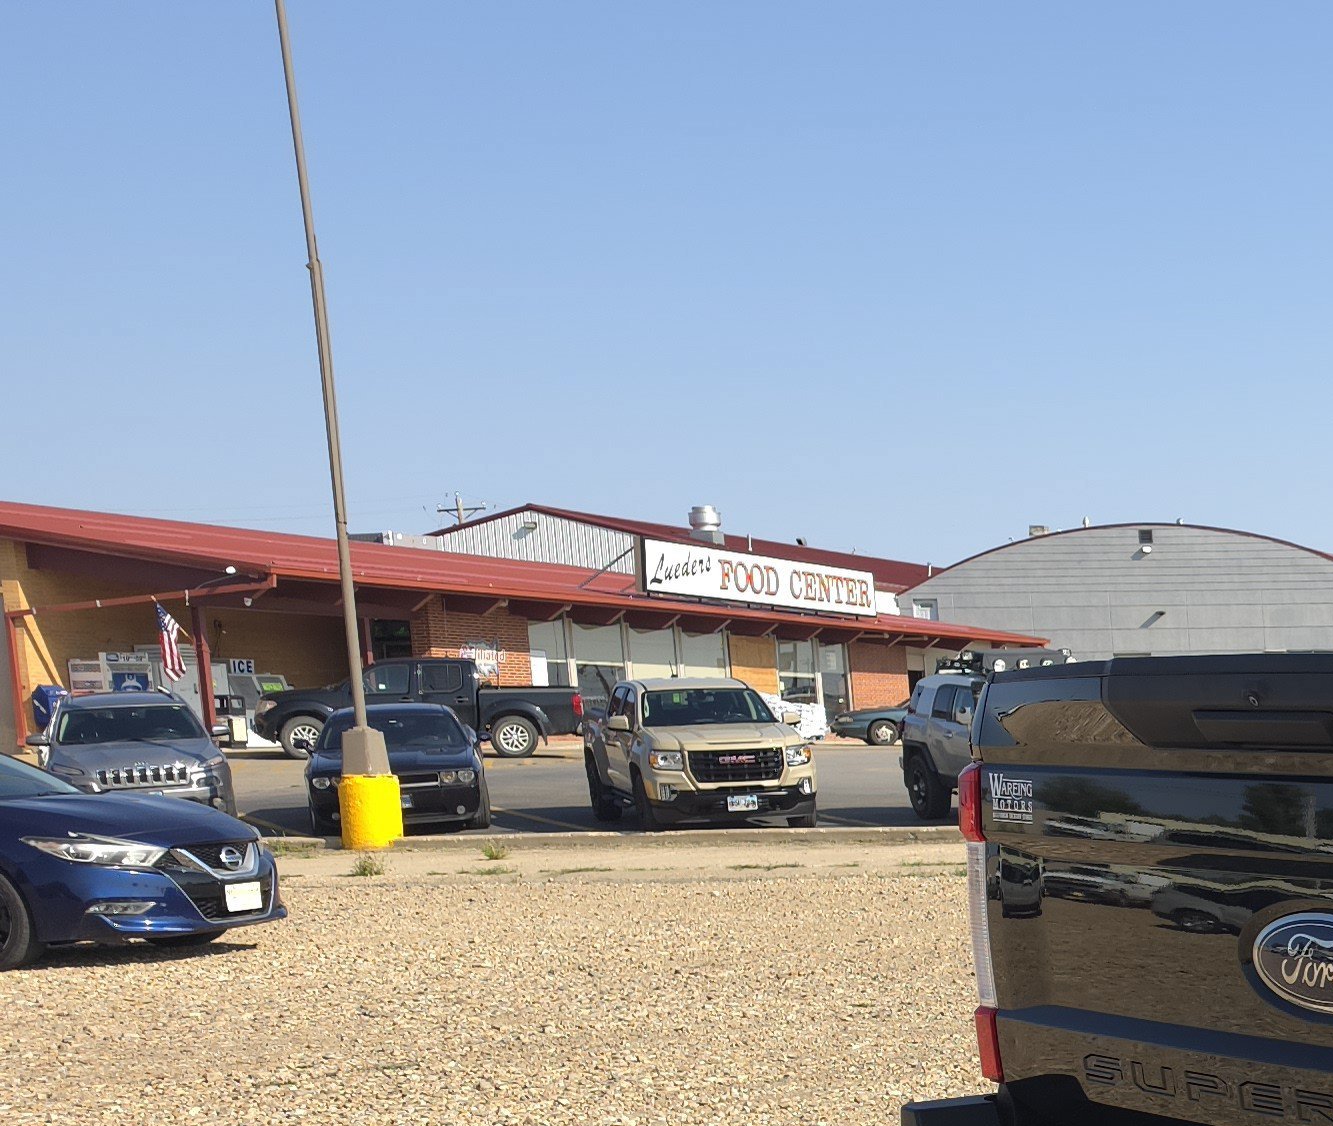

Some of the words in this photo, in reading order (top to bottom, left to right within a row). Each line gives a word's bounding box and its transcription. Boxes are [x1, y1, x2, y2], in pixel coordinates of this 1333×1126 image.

[650, 552, 711, 585] Lueders
[718, 558, 779, 596] FOOD
[789, 569, 872, 608] CENTER
[232, 660, 253, 673] ICE
[992, 798, 1033, 813] MOTORS
